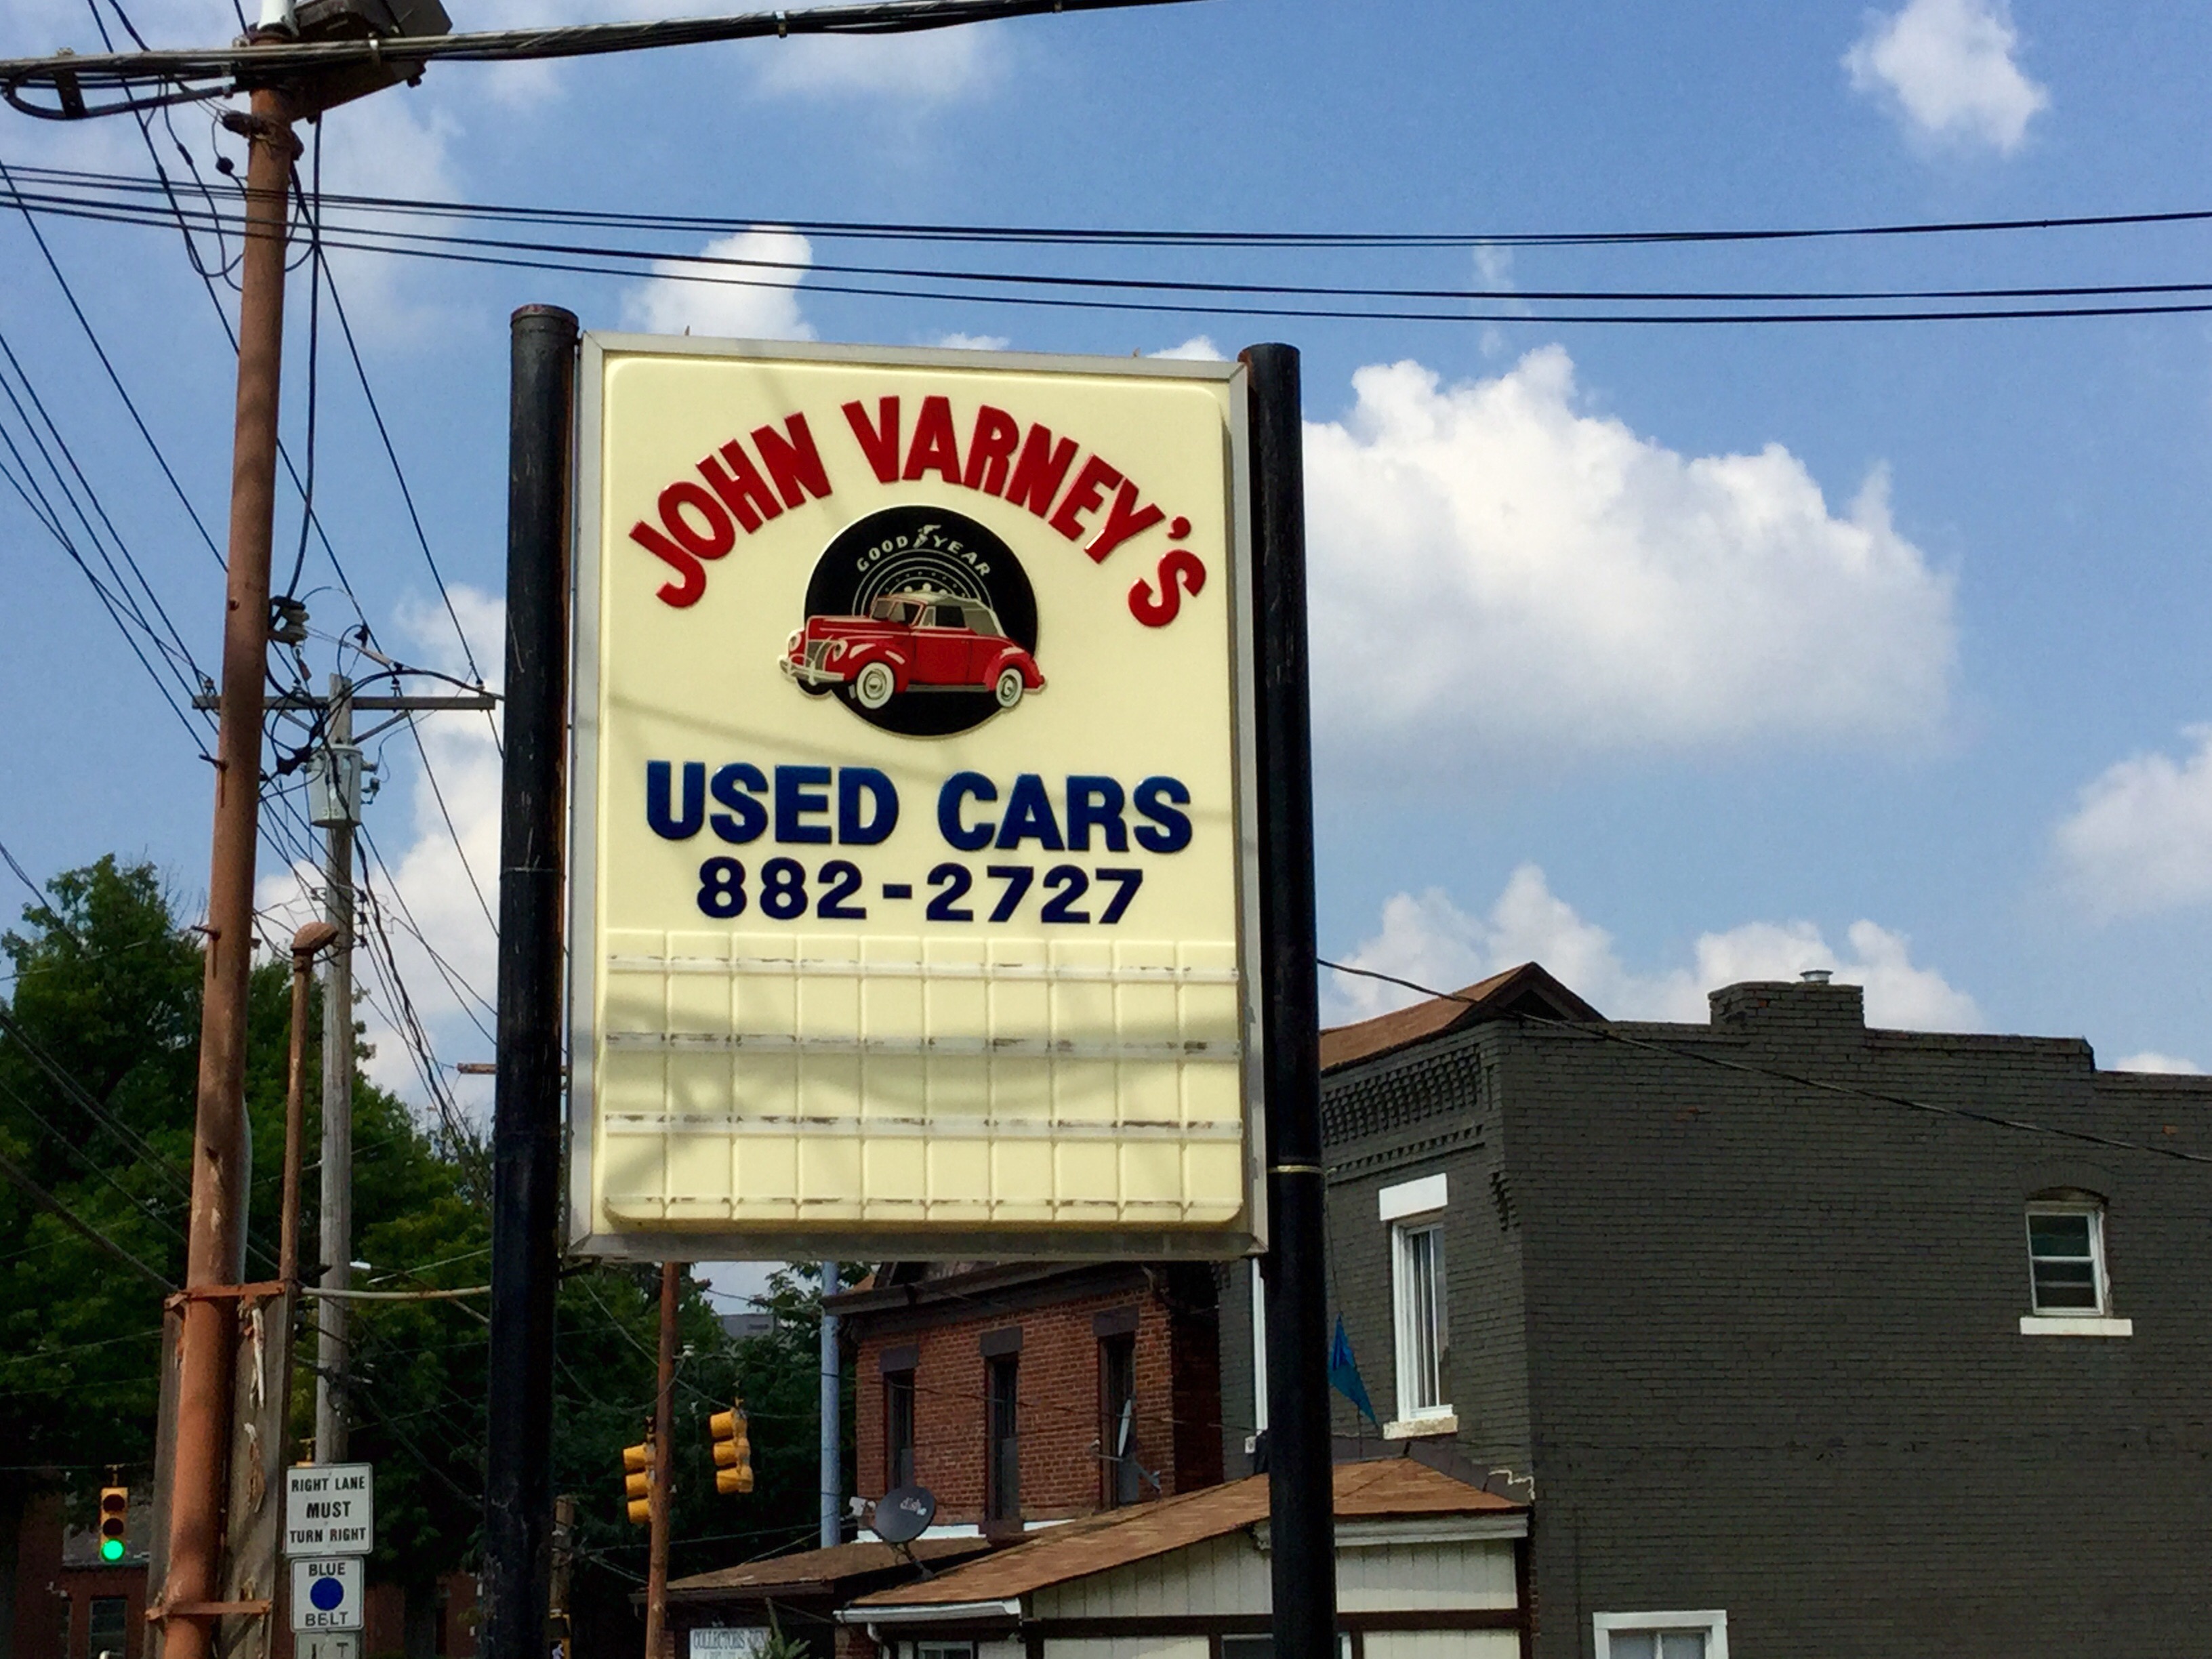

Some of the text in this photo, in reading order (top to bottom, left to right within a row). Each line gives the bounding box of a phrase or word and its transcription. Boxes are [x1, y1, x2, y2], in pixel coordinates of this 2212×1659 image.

[628, 395, 1208, 628] JOHN VARNEY'S
[646, 760, 1193, 855] USED CARS
[696, 855, 1144, 925] 882-2727
[291, 1475, 365, 1492] RIGHT LANE
[306, 1500, 352, 1519] MUST
[289, 1527, 367, 1544] TURN RIGHT
[308, 1561, 346, 1577] BLUE
[305, 1611, 349, 1627] BELT
